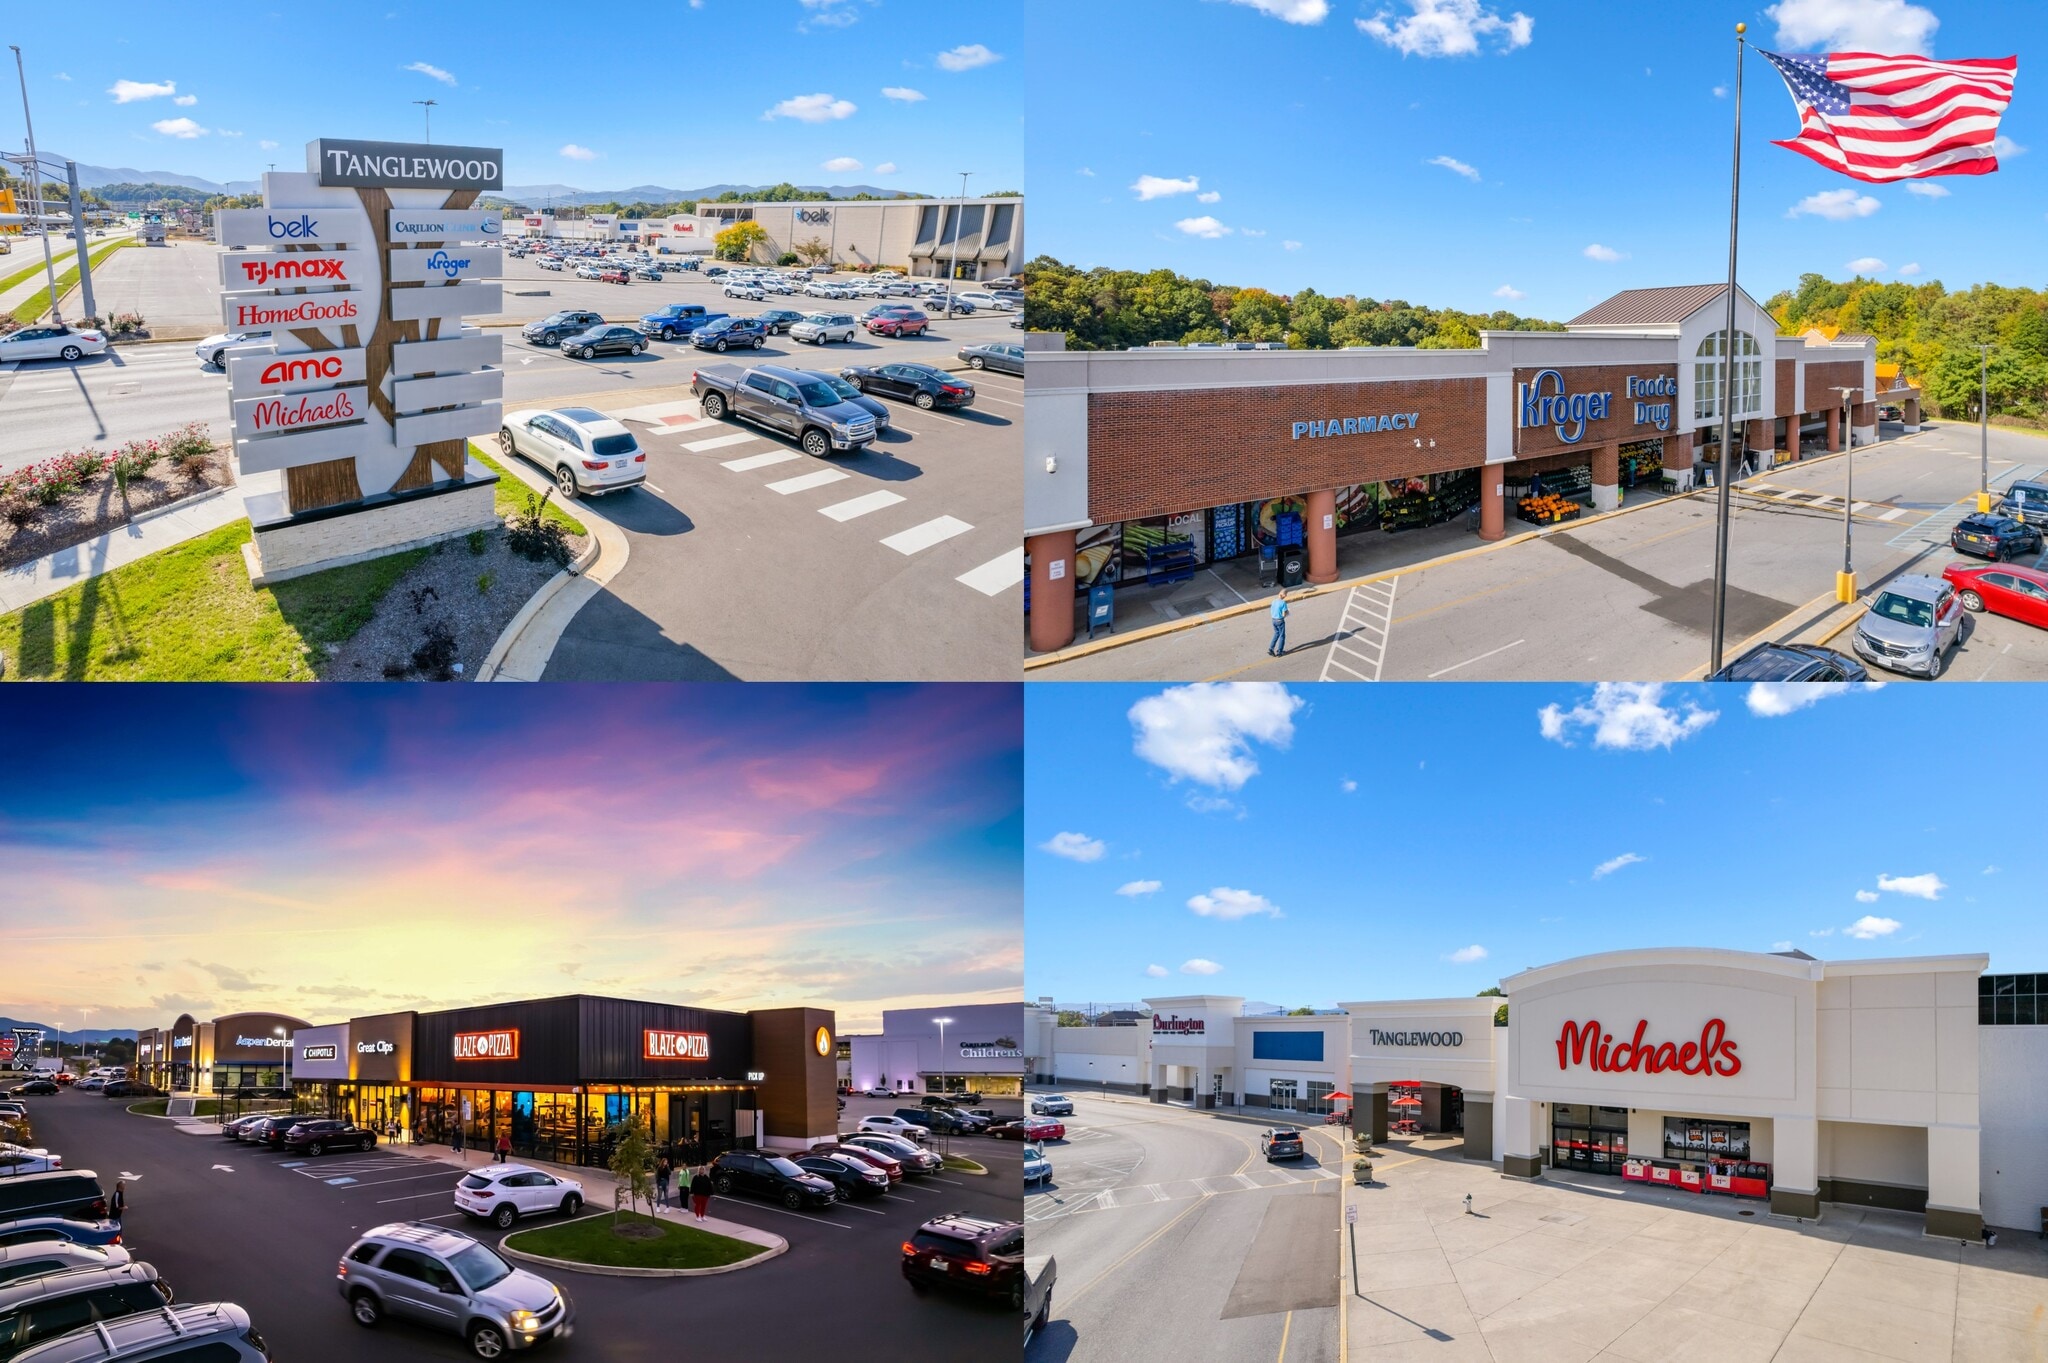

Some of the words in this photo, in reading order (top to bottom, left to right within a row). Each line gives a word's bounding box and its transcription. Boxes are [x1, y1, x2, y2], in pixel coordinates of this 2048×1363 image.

[327, 150, 498, 181] TANGLEWOOD
[268, 215, 319, 238] belk
[801, 207, 830, 223] belk
[395, 221, 444, 234] CARILION
[427, 250, 471, 277] Kroger
[236, 299, 357, 326] HomeGoods
[260, 356, 342, 384] amc
[1626, 374, 1665, 398] Food
[253, 392, 354, 429] Michaels
[1517, 369, 1612, 444] Kroger
[1634, 401, 1671, 431] Drug
[1292, 412, 1419, 440] PHARMACY
[1168, 513, 1202, 527] LOCAL
[1153, 1013, 1204, 1035] Burlington
[357, 1041, 376, 1053] Great
[376, 1041, 393, 1055] Clips
[454, 1036, 477, 1057] BLAZE
[488, 1033, 511, 1056] PIZZA
[649, 1032, 676, 1056] BLAZE
[688, 1035, 709, 1057] PIZZA
[1369, 1029, 1463, 1047] TANGLEWOOD
[1555, 1018, 1742, 1077] Michaels
[308, 1047, 333, 1057] CHIPOTLE
[960, 1048, 1023, 1058] Children's
